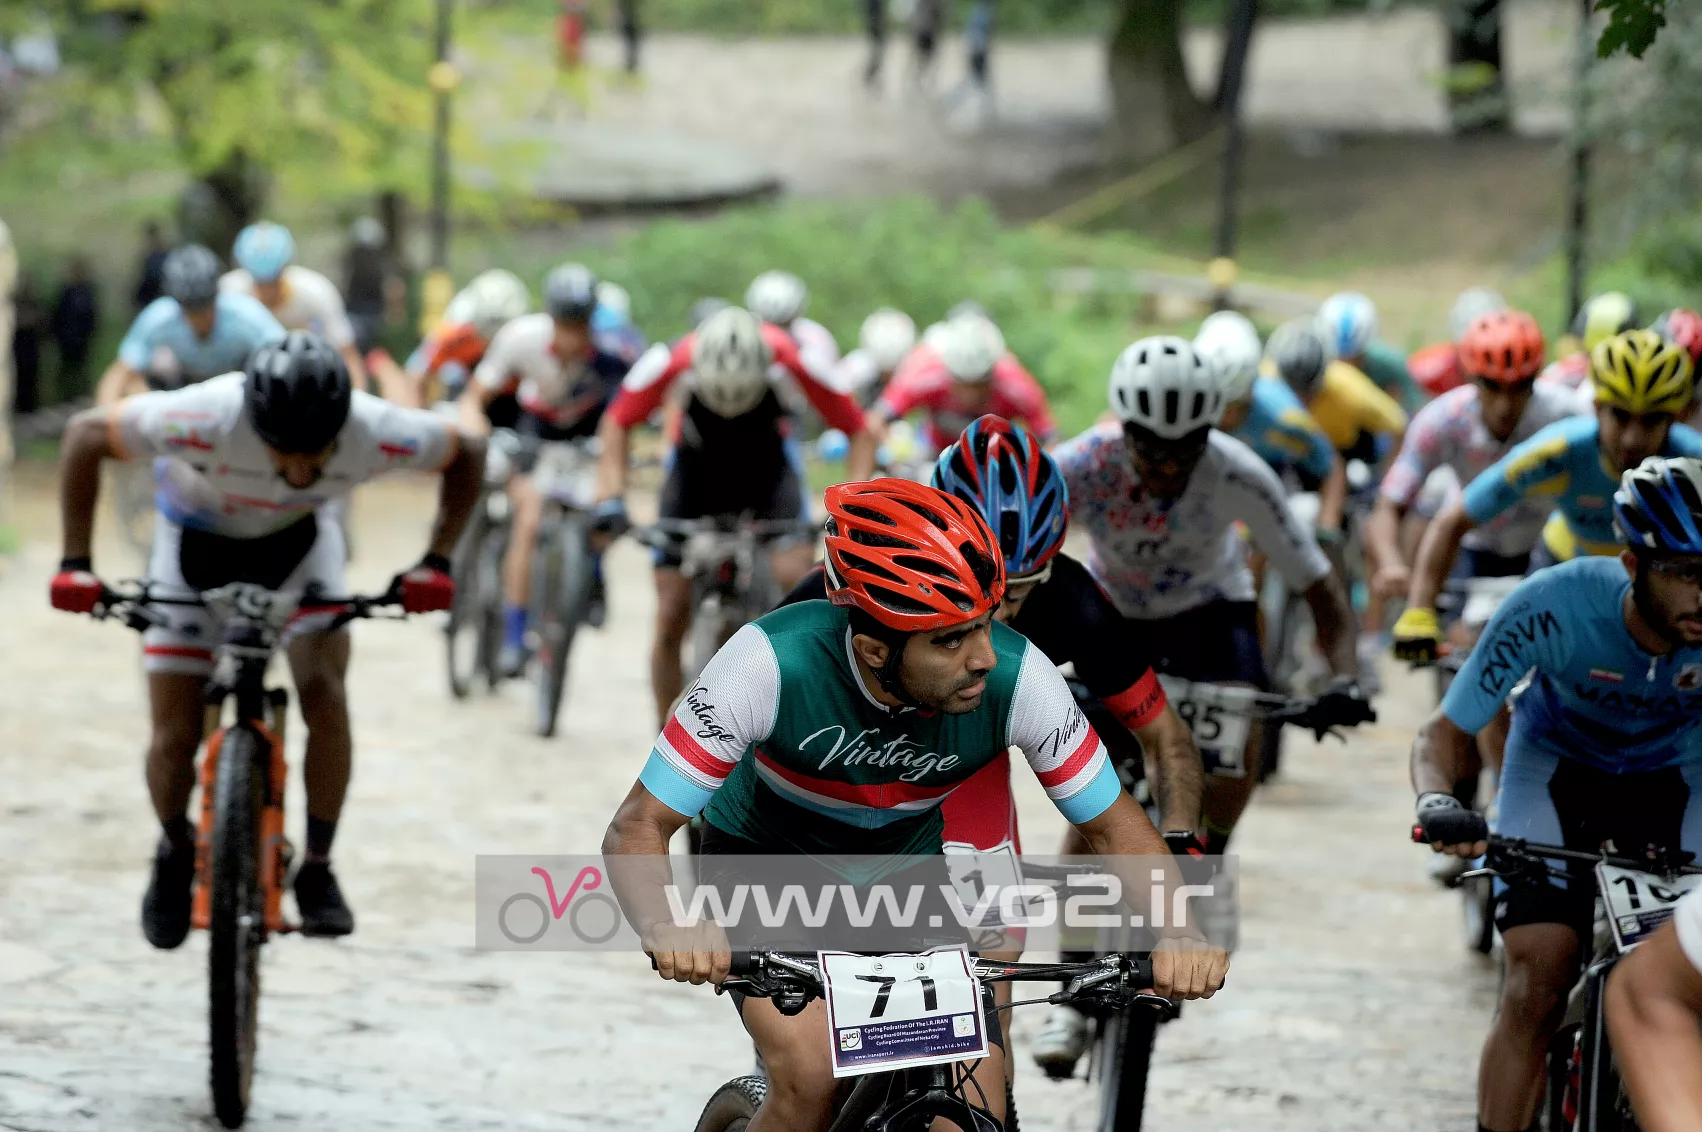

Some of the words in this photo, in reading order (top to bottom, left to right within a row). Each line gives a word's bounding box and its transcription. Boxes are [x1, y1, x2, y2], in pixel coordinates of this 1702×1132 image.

[687, 677, 736, 743] Vintage
[798, 725, 962, 782] Vintage
[854, 974, 938, 1018] 71
[864, 1026, 883, 1035] Cycling
[868, 1033, 883, 1041] Cycling
[928, 1026, 947, 1034] Province
